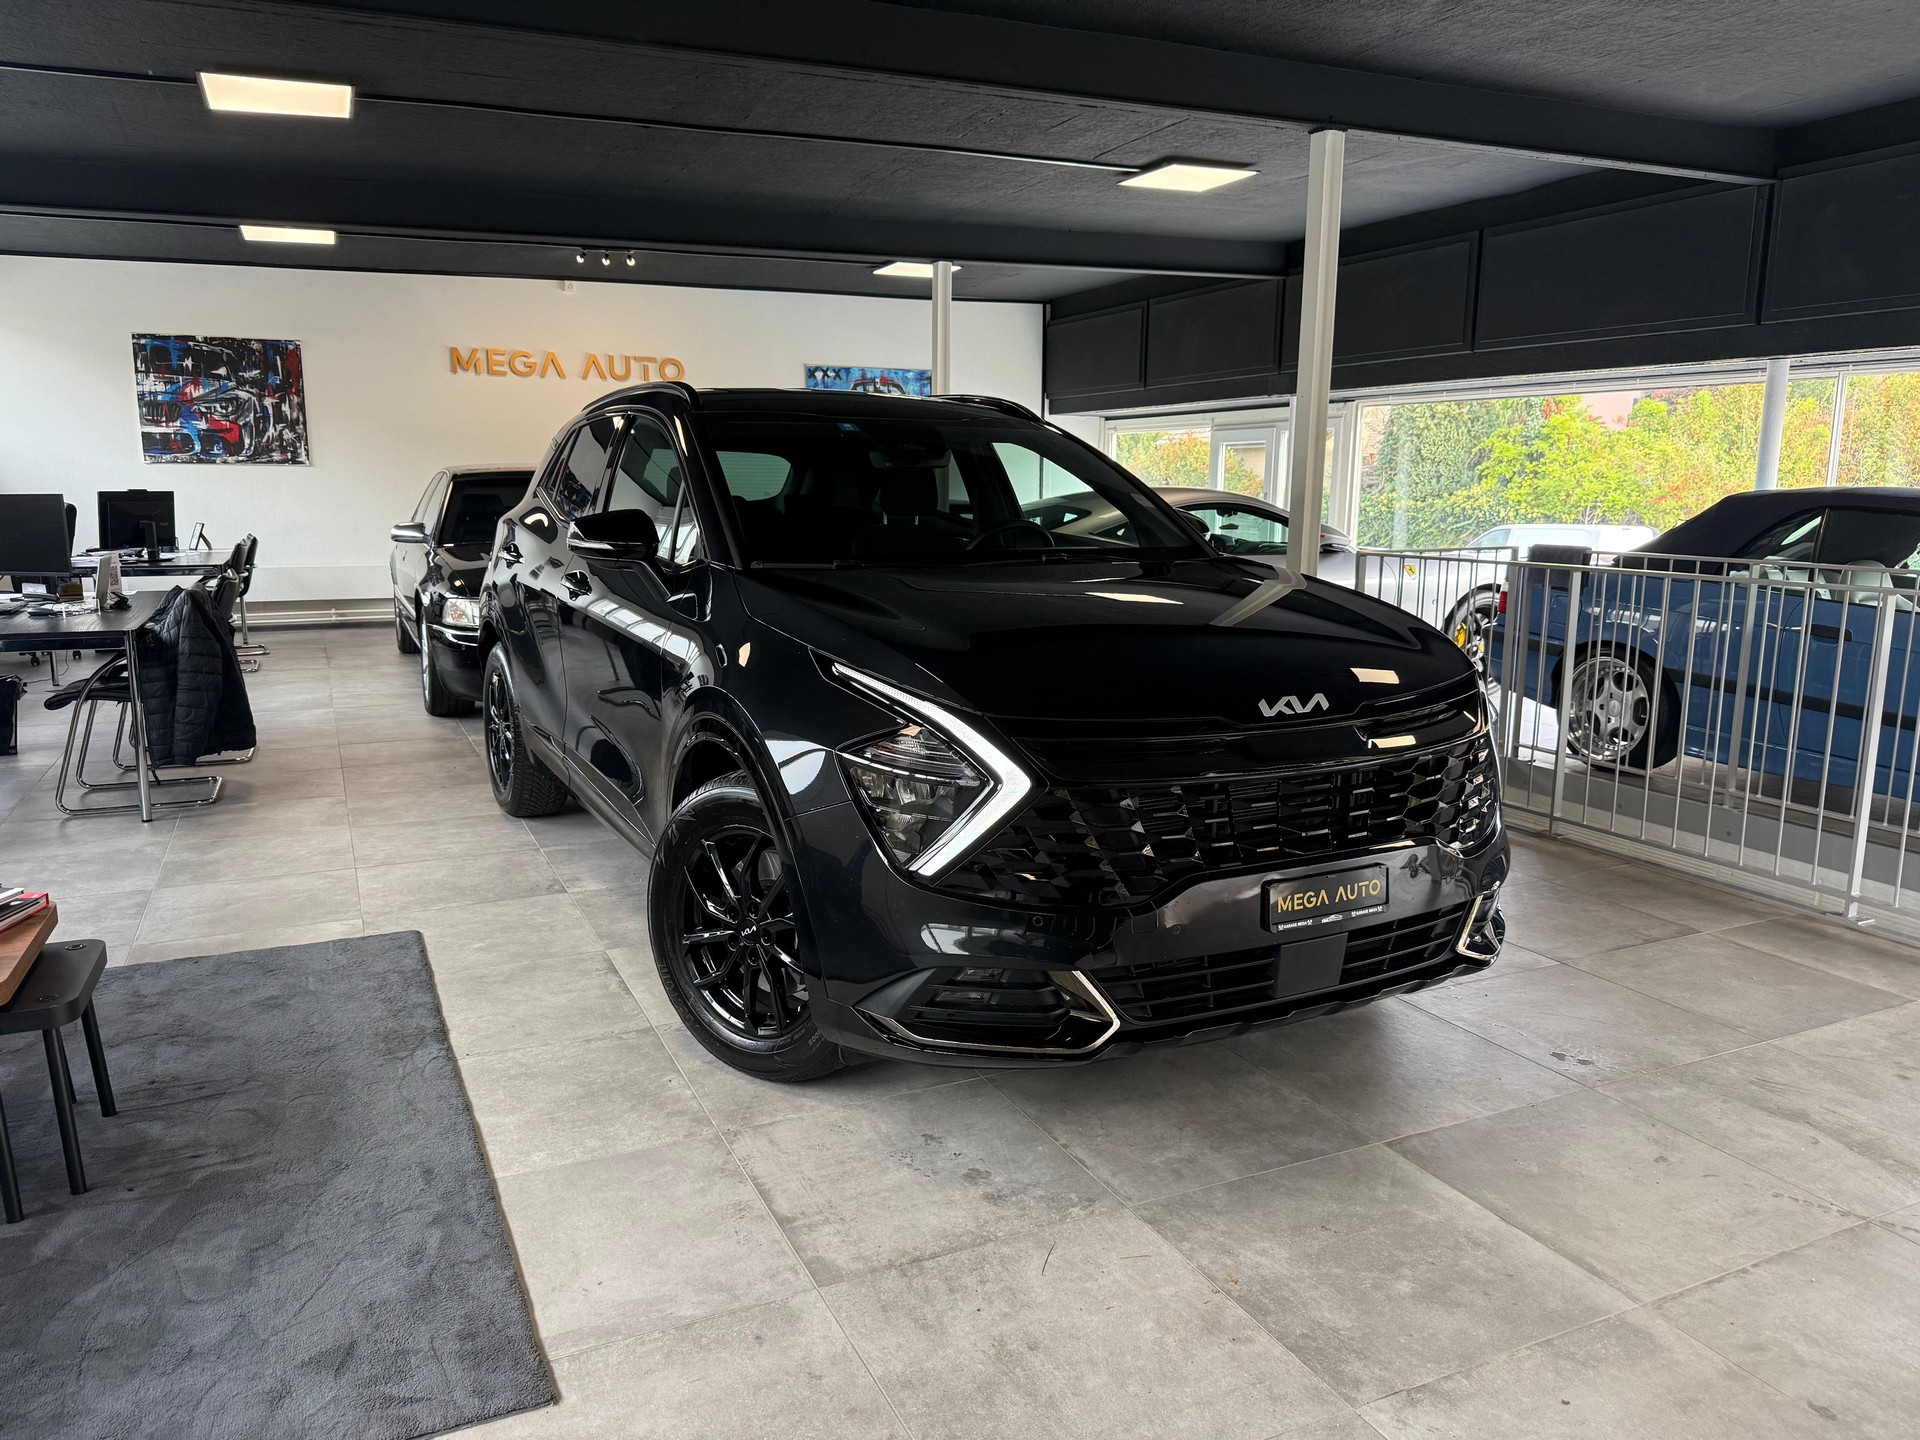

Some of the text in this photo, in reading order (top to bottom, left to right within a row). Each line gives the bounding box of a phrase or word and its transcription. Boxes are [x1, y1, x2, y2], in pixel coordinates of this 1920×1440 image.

[449, 346, 685, 382] MEGA AUTO
[1258, 693, 1330, 717] KIA
[1277, 879, 1381, 913] MEGA AUTO
[741, 925, 757, 936] KIA
